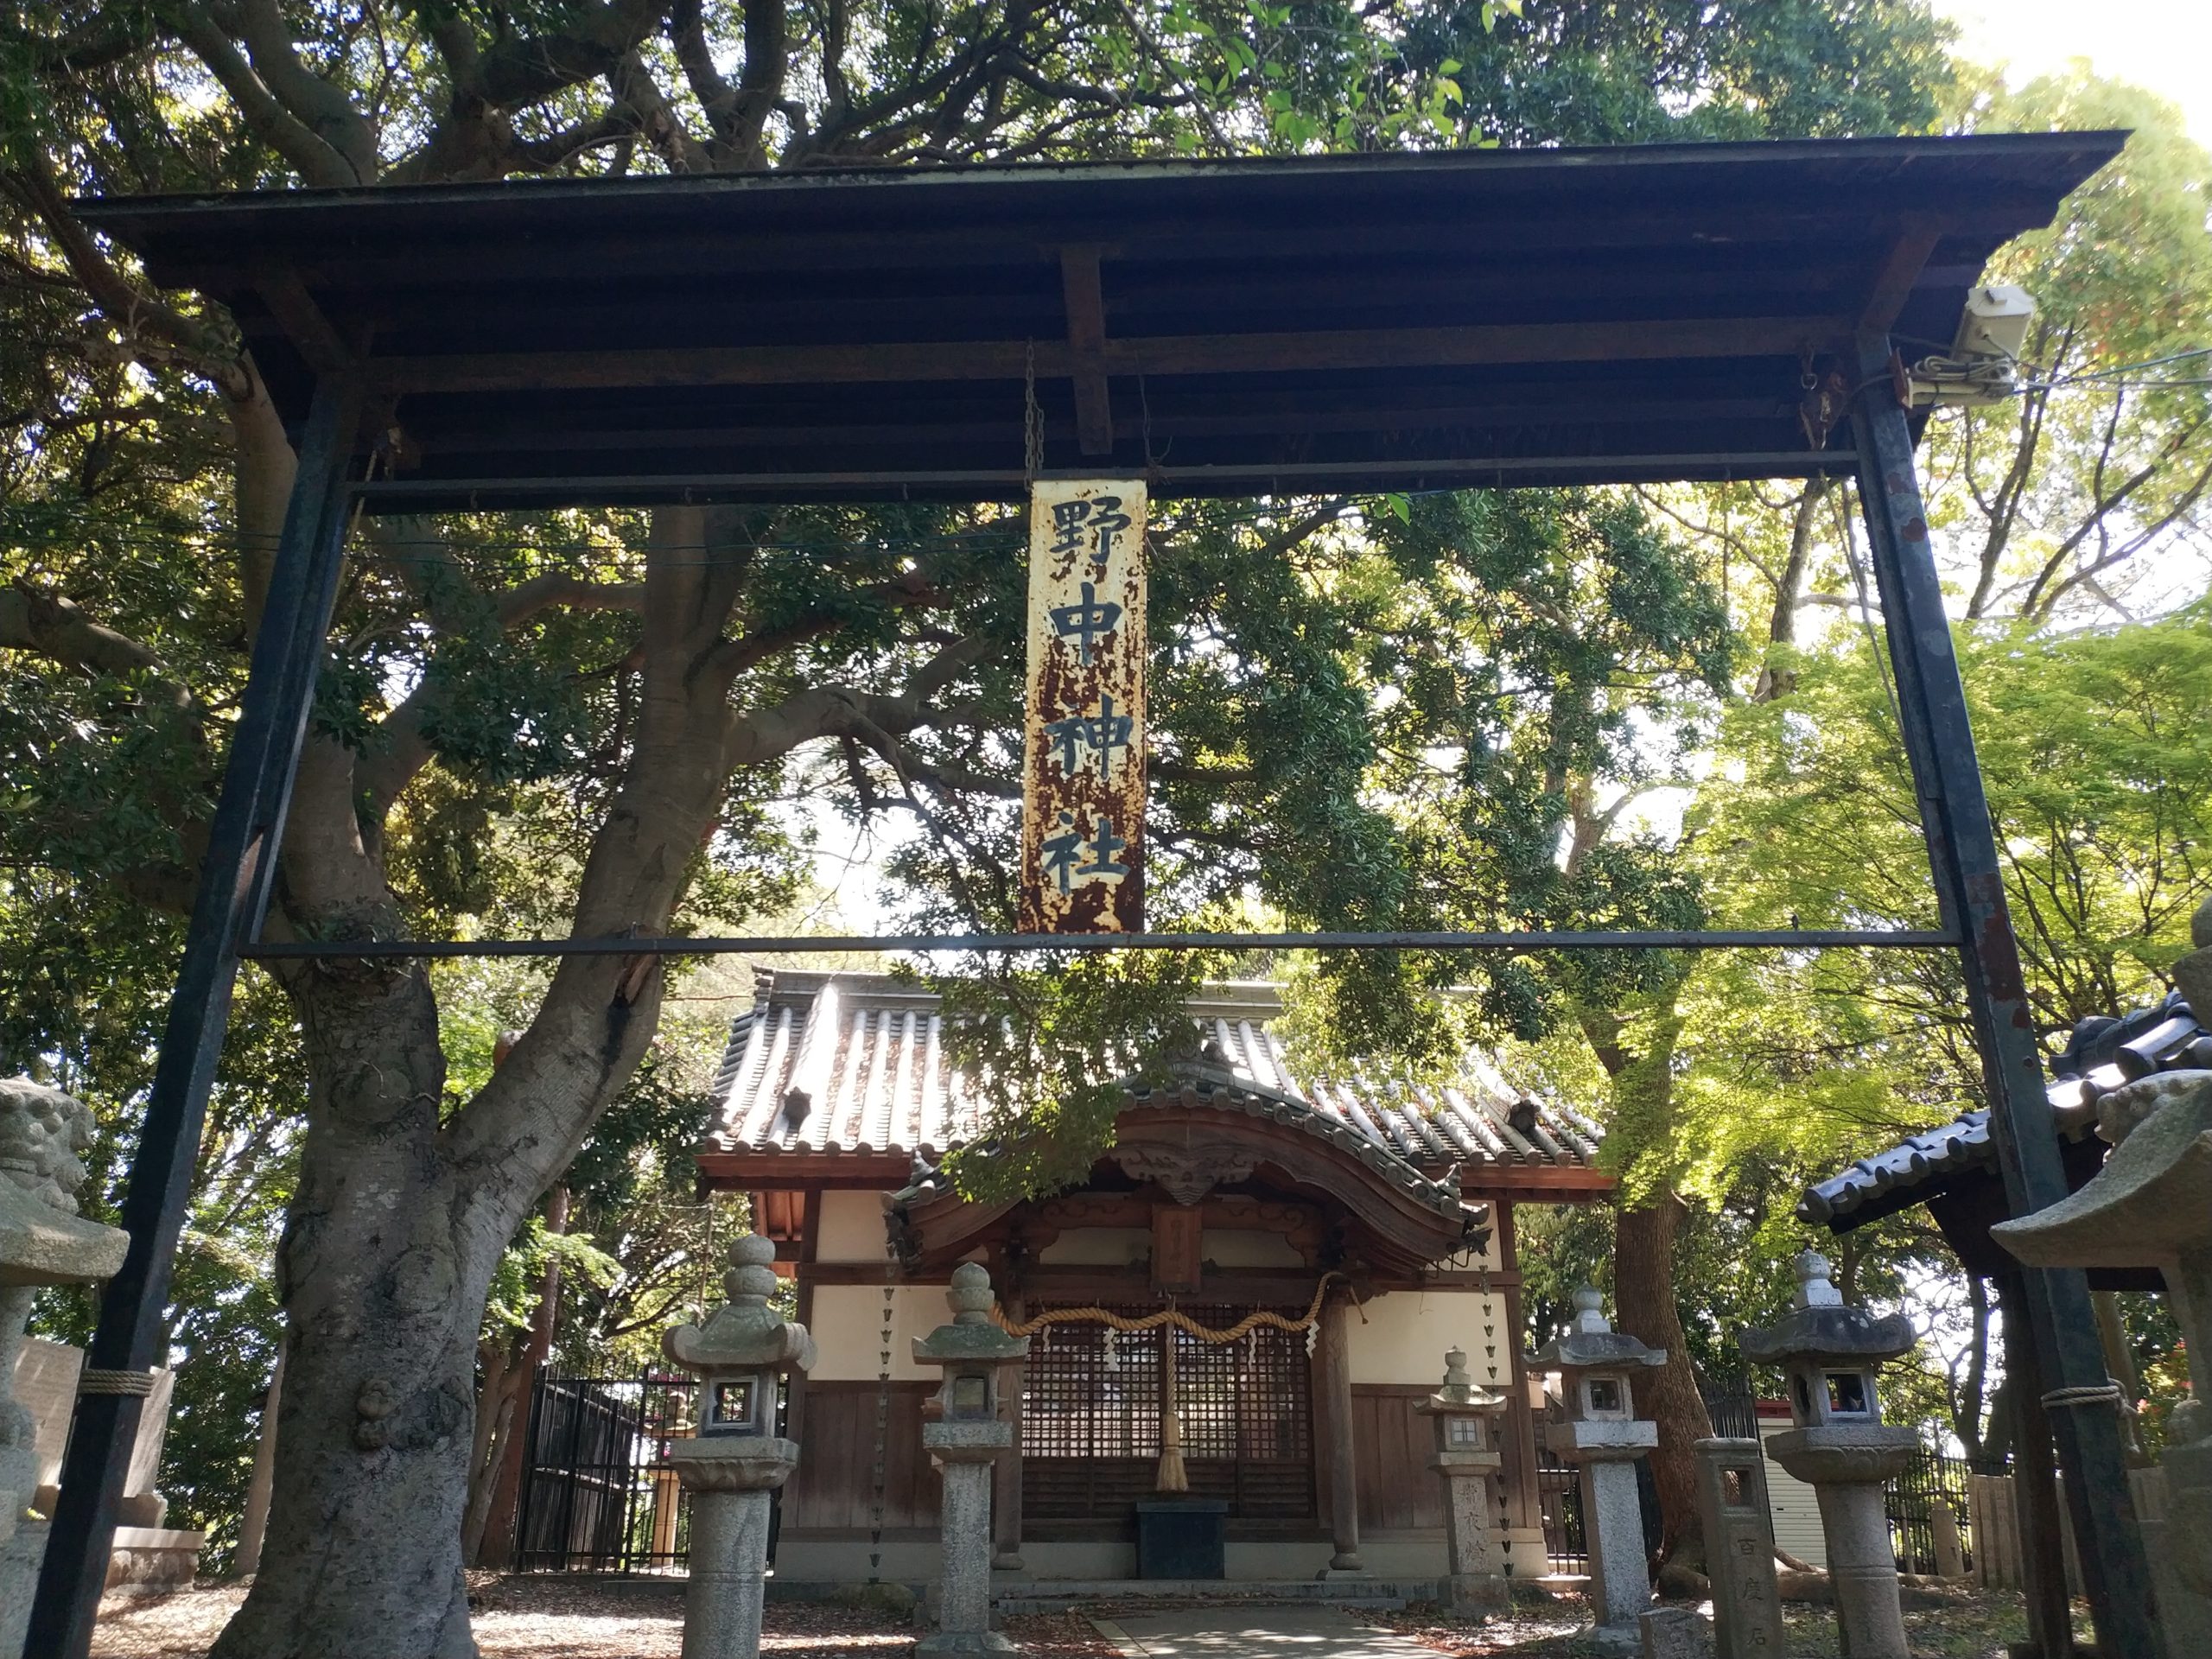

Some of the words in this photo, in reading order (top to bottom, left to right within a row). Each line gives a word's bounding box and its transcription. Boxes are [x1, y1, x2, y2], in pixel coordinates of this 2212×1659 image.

[1039, 496, 1134, 896] 野中神社
[1737, 1538, 1766, 1646] 百度石
